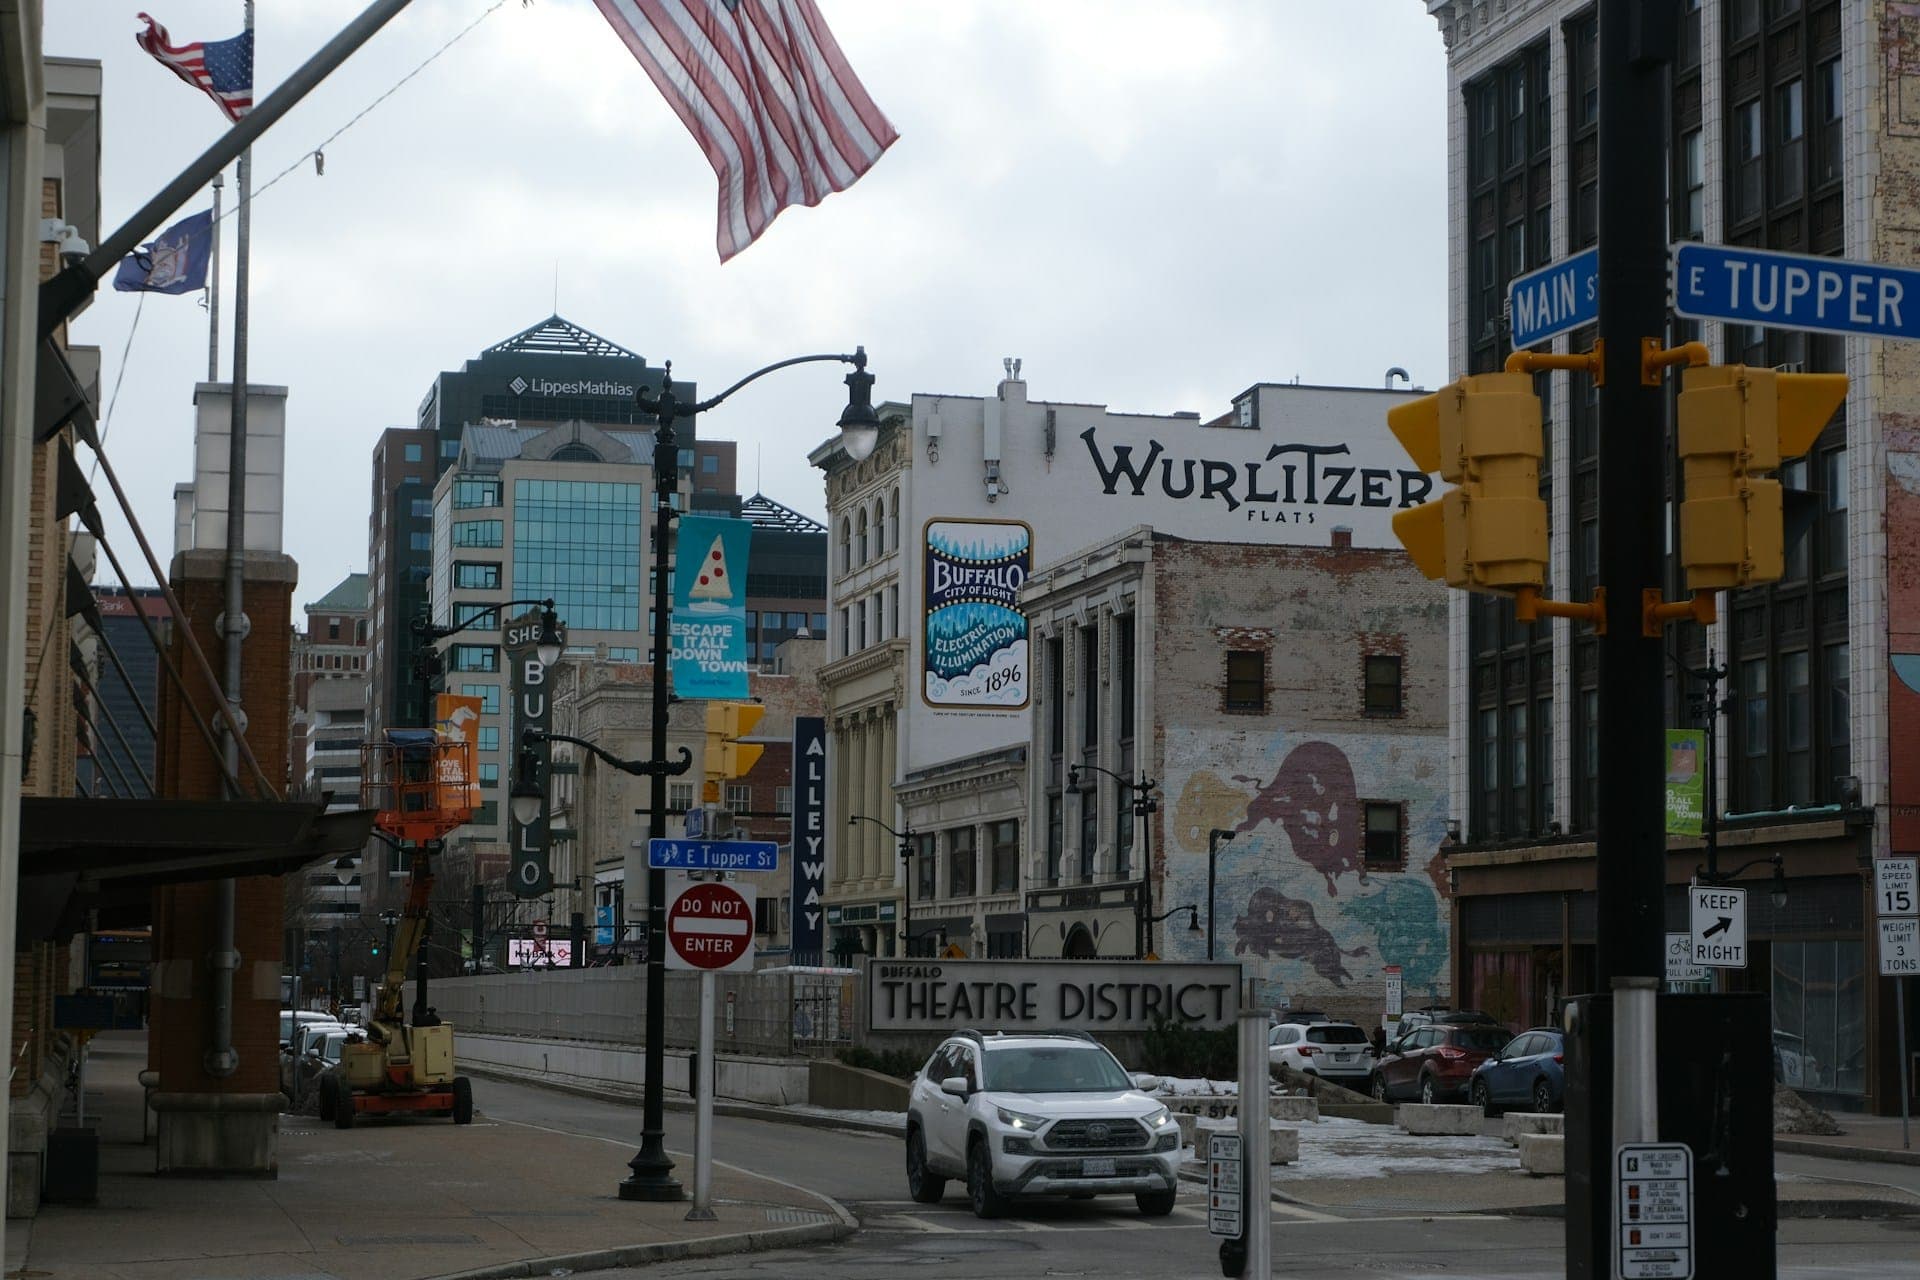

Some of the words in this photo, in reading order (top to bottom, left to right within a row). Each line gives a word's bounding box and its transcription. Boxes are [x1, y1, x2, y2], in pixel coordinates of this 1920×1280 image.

[1690, 266, 1705, 296] E
[1724, 260, 1904, 328] TUPPER
[1517, 268, 1576, 336] MAIN
[532, 378, 633, 396] LippesMathias
[1080, 427, 1433, 512] WURLITZER
[1247, 510, 1315, 523] FLATS
[933, 558, 1024, 593] BUFFALO
[945, 586, 967, 598] CITY
[968, 585, 981, 594] OF
[982, 586, 1012, 600] LIGHT
[671, 623, 733, 637] ESCAPE
[683, 636, 698, 648] IT
[699, 637, 729, 649] ALL
[935, 623, 987, 653] ELECTRIC
[671, 648, 722, 661] DOWN
[936, 626, 1016, 668] ILLUMINATION
[699, 661, 746, 672] TOWN
[960, 688, 981, 697] SINCE
[984, 664, 1021, 693] 1896
[801, 737, 825, 931] ALLEYWAY
[687, 849, 695, 863] E
[701, 845, 751, 867] Tupper
[1882, 872, 1912, 880] SPEED
[681, 899, 702, 912] DO
[711, 900, 742, 914] NOT
[1700, 895, 1738, 909] KEEP
[1885, 891, 1911, 911] 15
[1882, 922, 1916, 931] WEIGHT
[685, 938, 733, 952] ENTER
[1888, 933, 1912, 942] LIMIT
[1697, 945, 1742, 960] RIGHT
[1896, 945, 1905, 956] 3
[1685, 968, 1702, 976] LANE
[1886, 959, 1917, 970] TONS
[881, 967, 942, 978] BUFFALO
[881, 982, 1038, 1020] THEATRE
[1060, 983, 1231, 1020] DISTRICT
